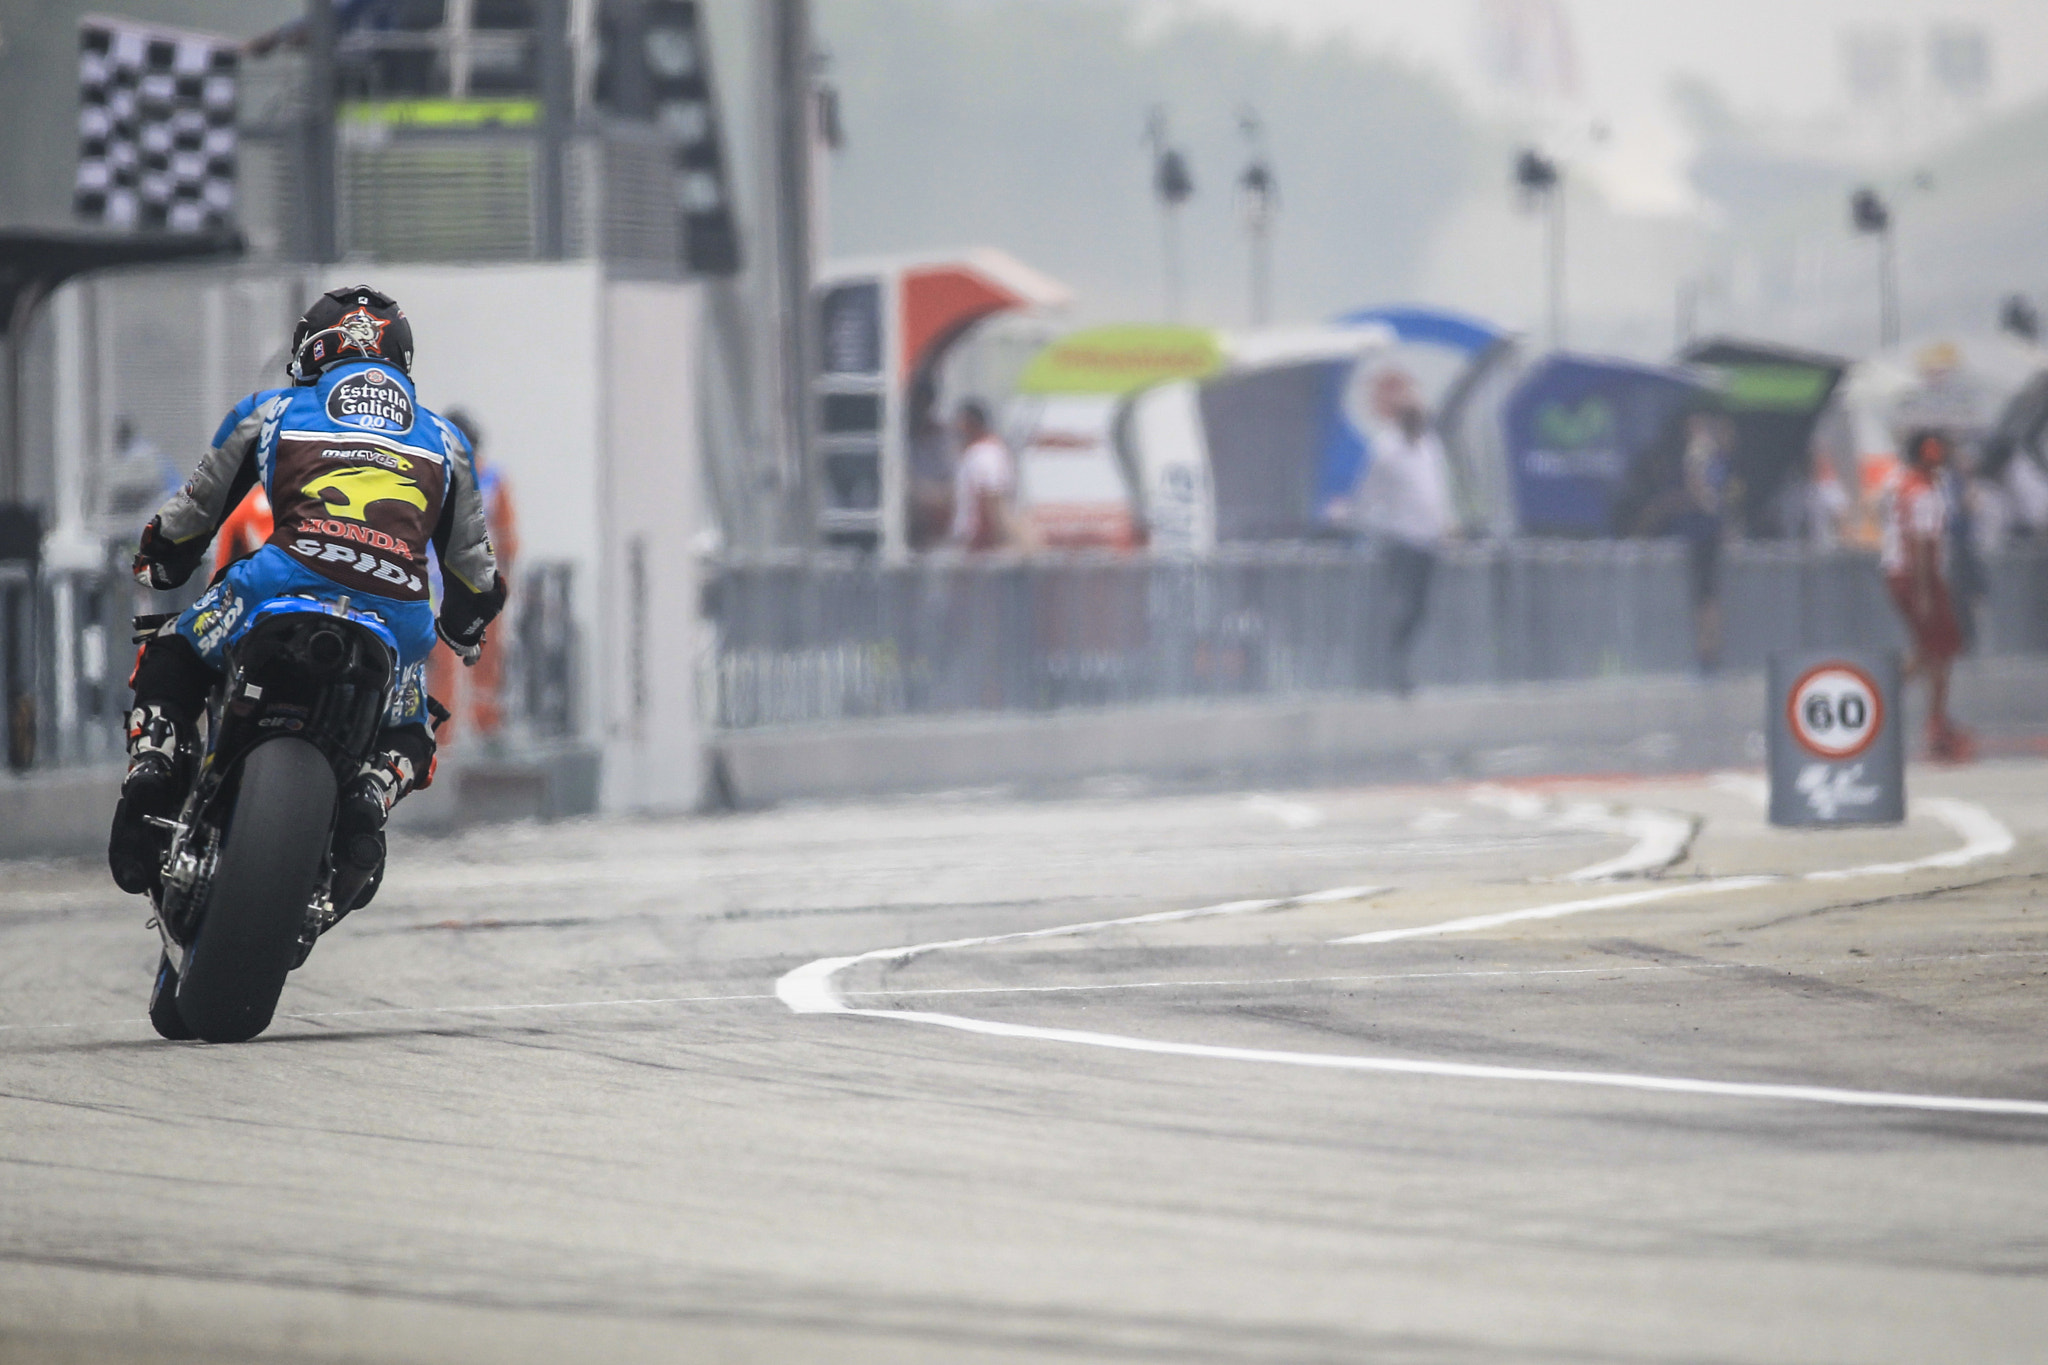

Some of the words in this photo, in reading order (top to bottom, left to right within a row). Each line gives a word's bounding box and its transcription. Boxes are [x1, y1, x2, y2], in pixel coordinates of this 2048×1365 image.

[338, 383, 407, 411] Estrella
[341, 398, 404, 426] Galicia
[298, 519, 413, 561] HONDA
[289, 539, 423, 592] SPIDI
[1804, 693, 1866, 732] 60
